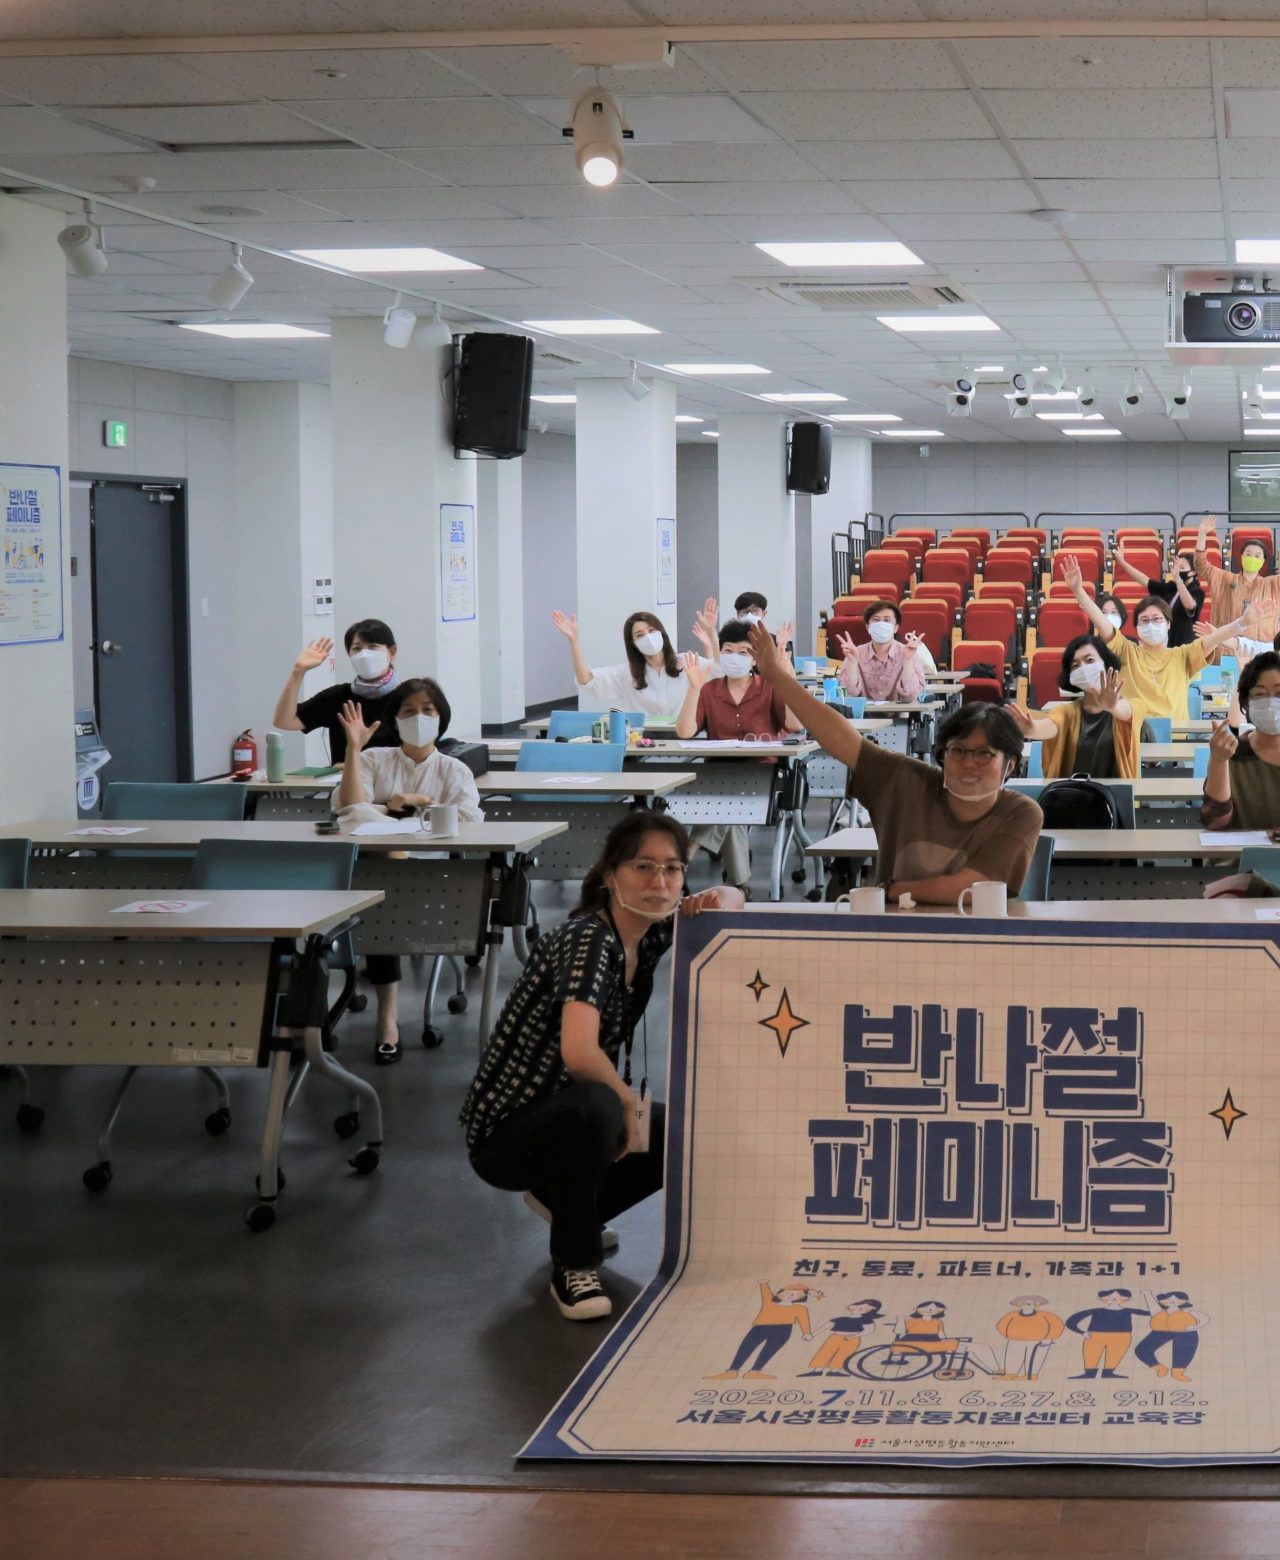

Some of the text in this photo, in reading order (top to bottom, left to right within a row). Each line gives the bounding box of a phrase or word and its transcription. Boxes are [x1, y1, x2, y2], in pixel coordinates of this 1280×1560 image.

[843, 1003, 1144, 1118] 반나절
[805, 1117, 1175, 1235] 페미니즘
[792, 1259, 1181, 1279] 친구, 동료, 파트너, 가족과 1+1
[1113, 1390, 1209, 1407] 9.12.
[676, 1409, 1206, 1426] 서울시성평등활동지원센터 교육장
